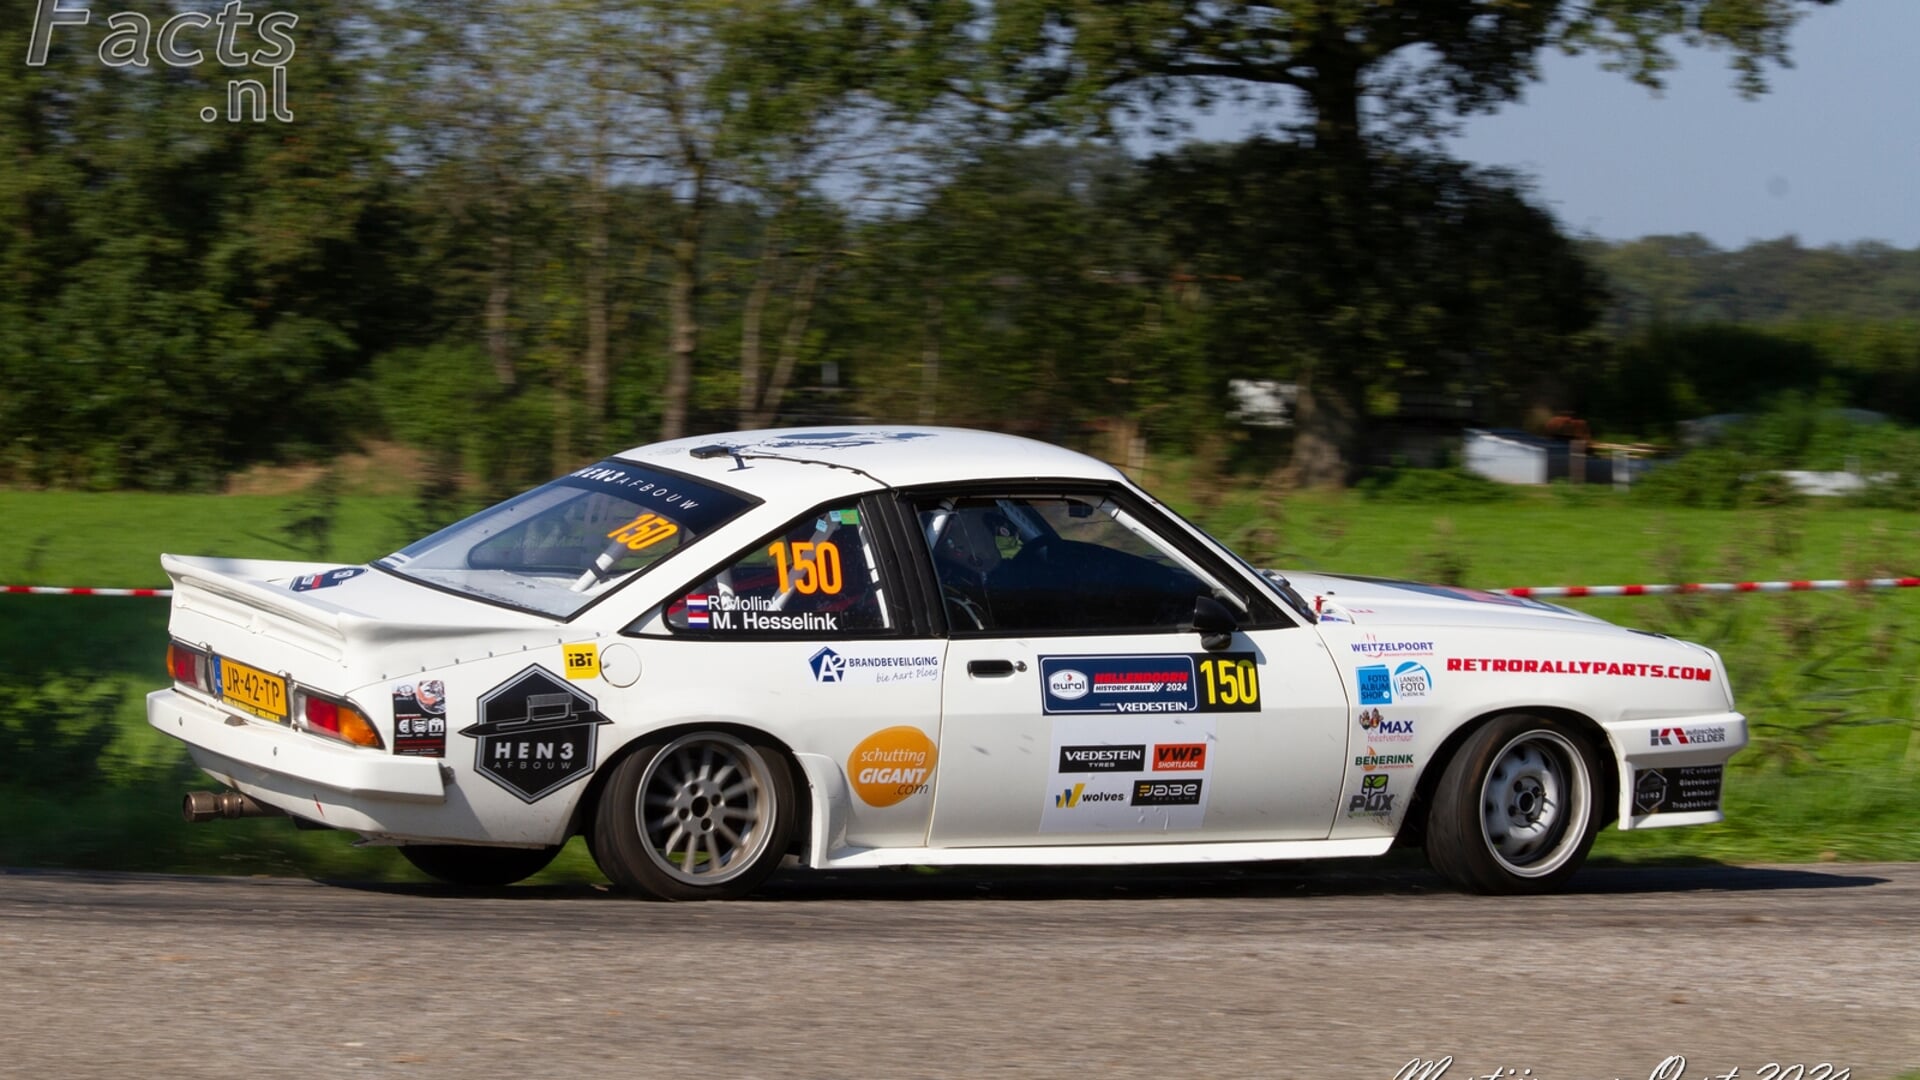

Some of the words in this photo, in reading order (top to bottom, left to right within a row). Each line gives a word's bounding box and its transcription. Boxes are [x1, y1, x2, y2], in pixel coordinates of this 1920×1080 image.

[615, 476, 700, 511] AFBOUW
[607, 513, 679, 550] 150
[769, 541, 842, 595] 150
[712, 611, 738, 630] M.
[743, 611, 838, 630] Hesselink
[1351, 641, 1434, 652] WEITZELPOORT
[849, 657, 938, 668] BRANDBEVEILIGING
[1447, 658, 1711, 681] RETRORALLYPARTS.COM
[226, 665, 281, 708] JR-42-TP
[1052, 681, 1086, 691] eurol
[1095, 684, 1128, 692] HISTORIC
[1129, 683, 1151, 691] RALLY
[1166, 682, 1188, 692] 2024
[1200, 659, 1257, 705] 150
[1400, 683, 1426, 692] FOTO
[1116, 702, 1188, 712] VREDESTEIN
[1379, 721, 1414, 734] MAX
[1690, 735, 1726, 744] KELDER
[495, 743, 574, 759] HEN3
[1064, 750, 1142, 761] VREDESTEIN
[1158, 748, 1203, 761] VWP
[861, 749, 927, 767] schutting
[1355, 754, 1414, 766] BENERINK
[1157, 761, 1199, 769] SHORTLEASE
[859, 768, 927, 784] GIGANT
[893, 784, 929, 795] .com
[1082, 791, 1124, 802] wolves
